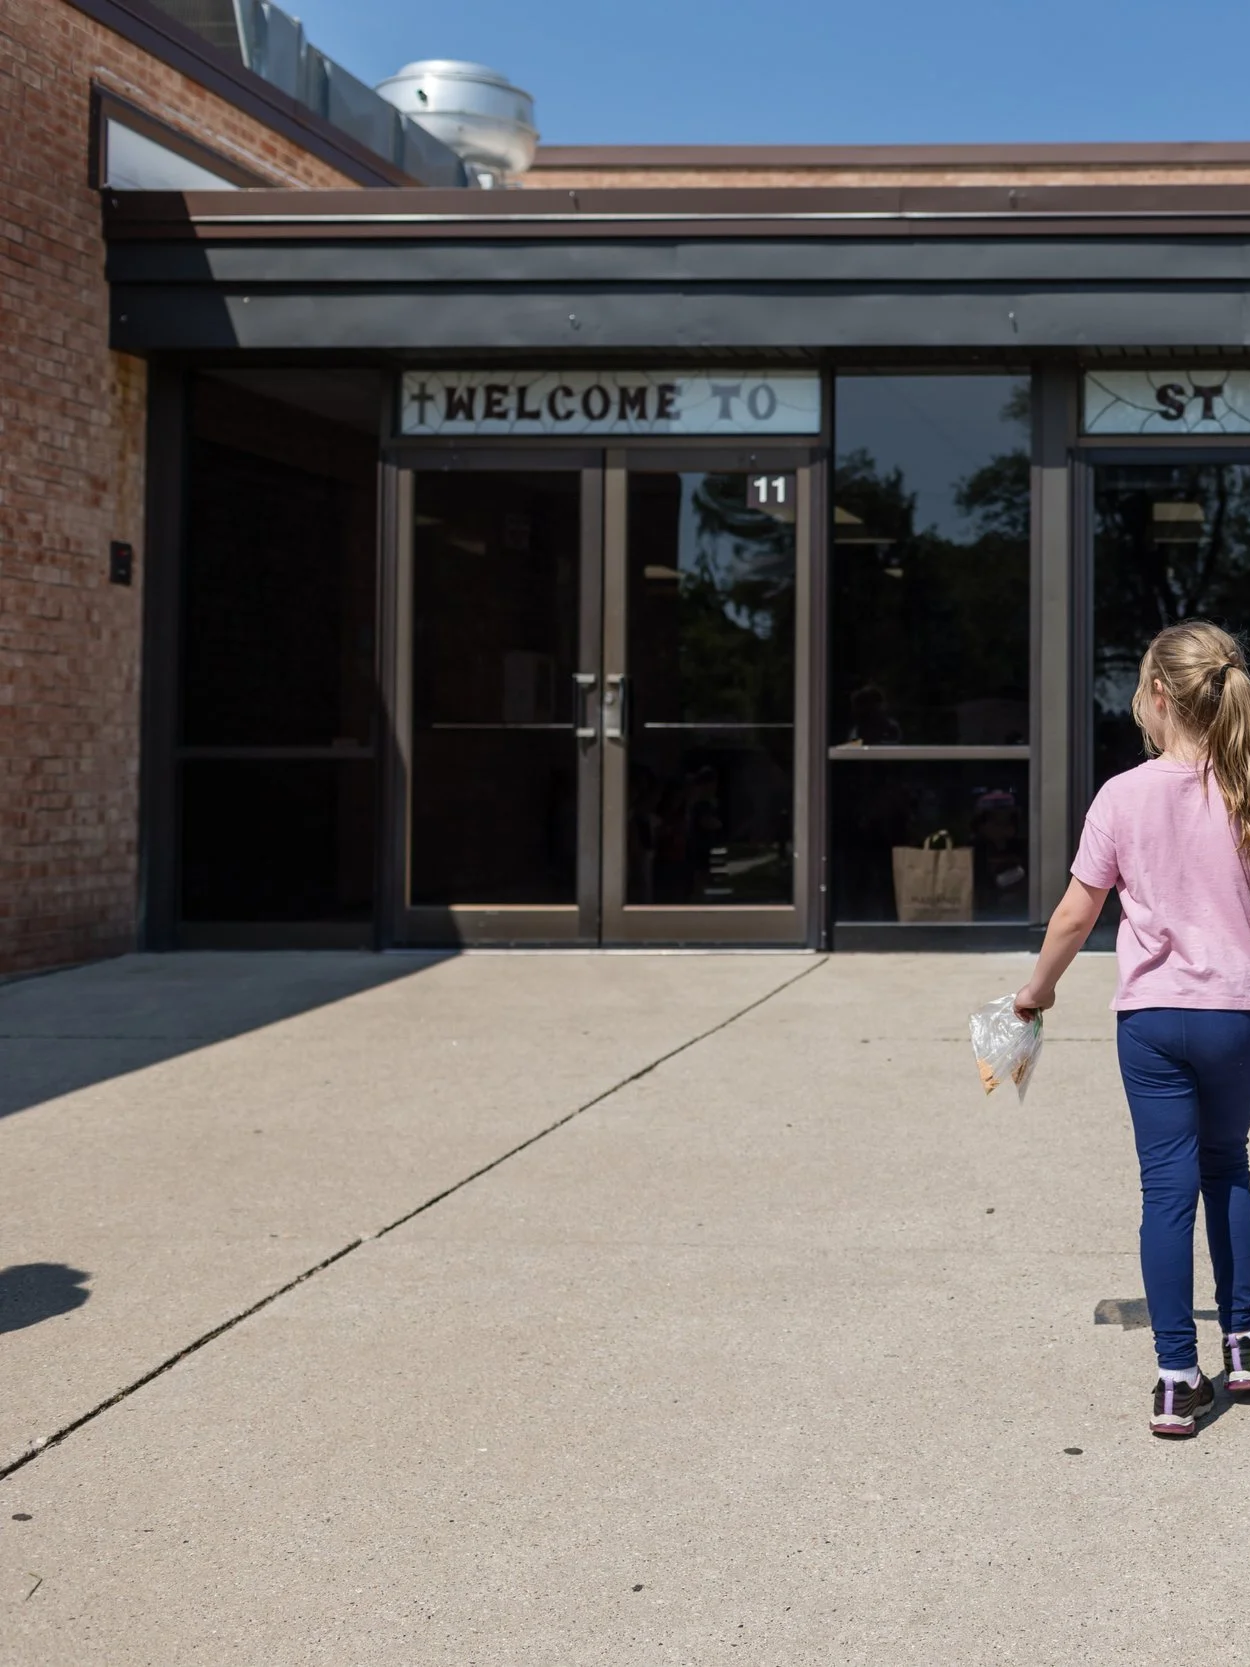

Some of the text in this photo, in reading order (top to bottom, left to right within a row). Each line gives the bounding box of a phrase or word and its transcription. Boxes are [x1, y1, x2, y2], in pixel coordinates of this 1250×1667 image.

[444, 384, 777, 421] WELCOME TO
[1156, 383, 1224, 421] ST
[754, 476, 786, 503] 11
